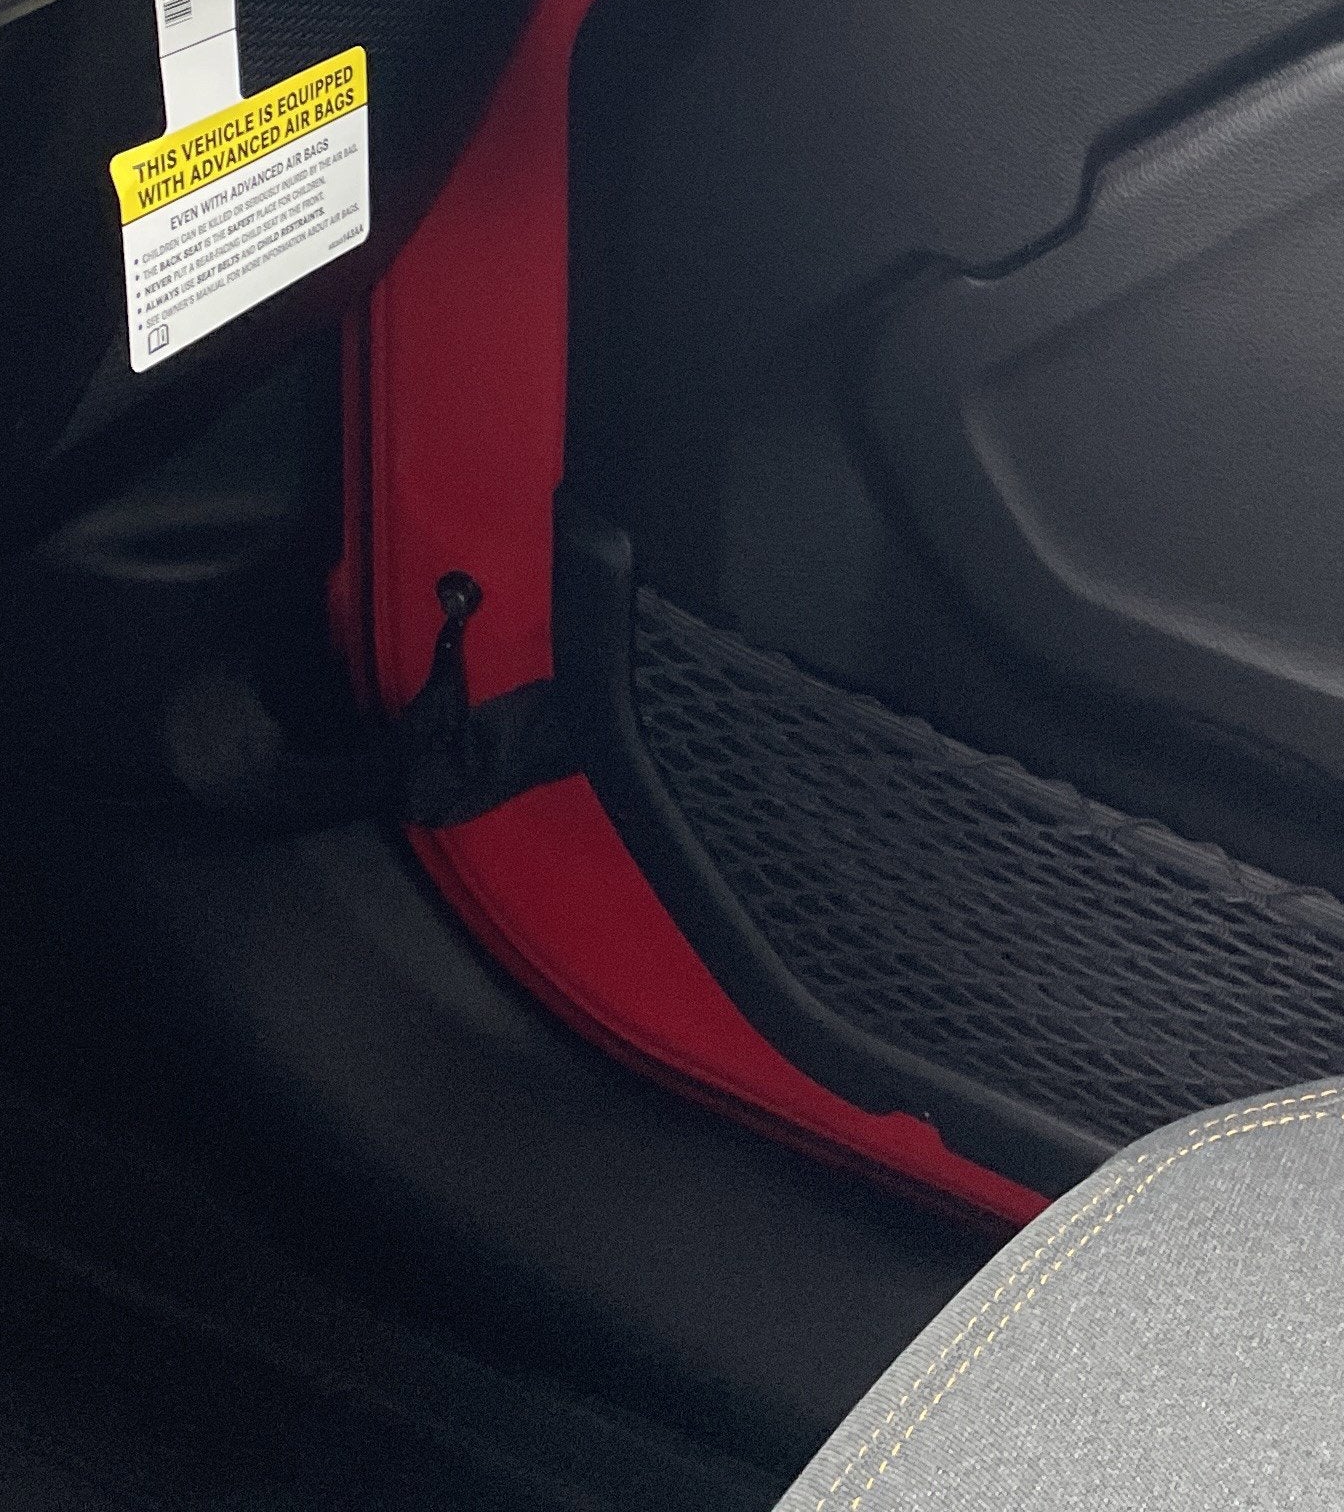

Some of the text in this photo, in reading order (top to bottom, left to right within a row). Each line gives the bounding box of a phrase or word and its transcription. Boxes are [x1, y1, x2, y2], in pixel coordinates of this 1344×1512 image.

[133, 65, 354, 184] THIS VEHICLE IS EQUIPPED
[137, 87, 355, 210] WITH ADVANCED AIR BAGS
[142, 235, 179, 264] CHILDREN
[180, 227, 196, 244] CAN
[198, 221, 206, 234] BE
[208, 208, 232, 229] KILLED
[233, 202, 243, 216] OR
[319, 156, 330, 171] THE
[170, 137, 328, 231] EVEN WITH ADVANCED AIR BAGS
[143, 263, 158, 280] THE
[159, 251, 182, 272] BACK
[183, 240, 202, 259] SEAT
[204, 235, 210, 248] IS
[212, 228, 225, 243] THE
[227, 212, 254, 235] SAFEST
[256, 201, 276, 220] PLACE
[278, 193, 290, 208] FOR
[144, 273, 172, 296] NEVER
[173, 264, 187, 281] PUT
[188, 260, 194, 272] A
[263, 215, 278, 232] SEAT
[288, 203, 300, 218] THE
[145, 286, 178, 312] ALWAYS
[180, 277, 194, 293] USE
[196, 265, 215, 284] SEAT
[217, 252, 239, 273] BELTS
[241, 243, 255, 259] AND
[257, 230, 279, 251] CHILD
[146, 313, 159, 329] SEE
[196, 276, 225, 301] MANUAL
[226, 267, 240, 284] FOR
[241, 256, 261, 275] MORE
[307, 218, 328, 238] ABOUT
